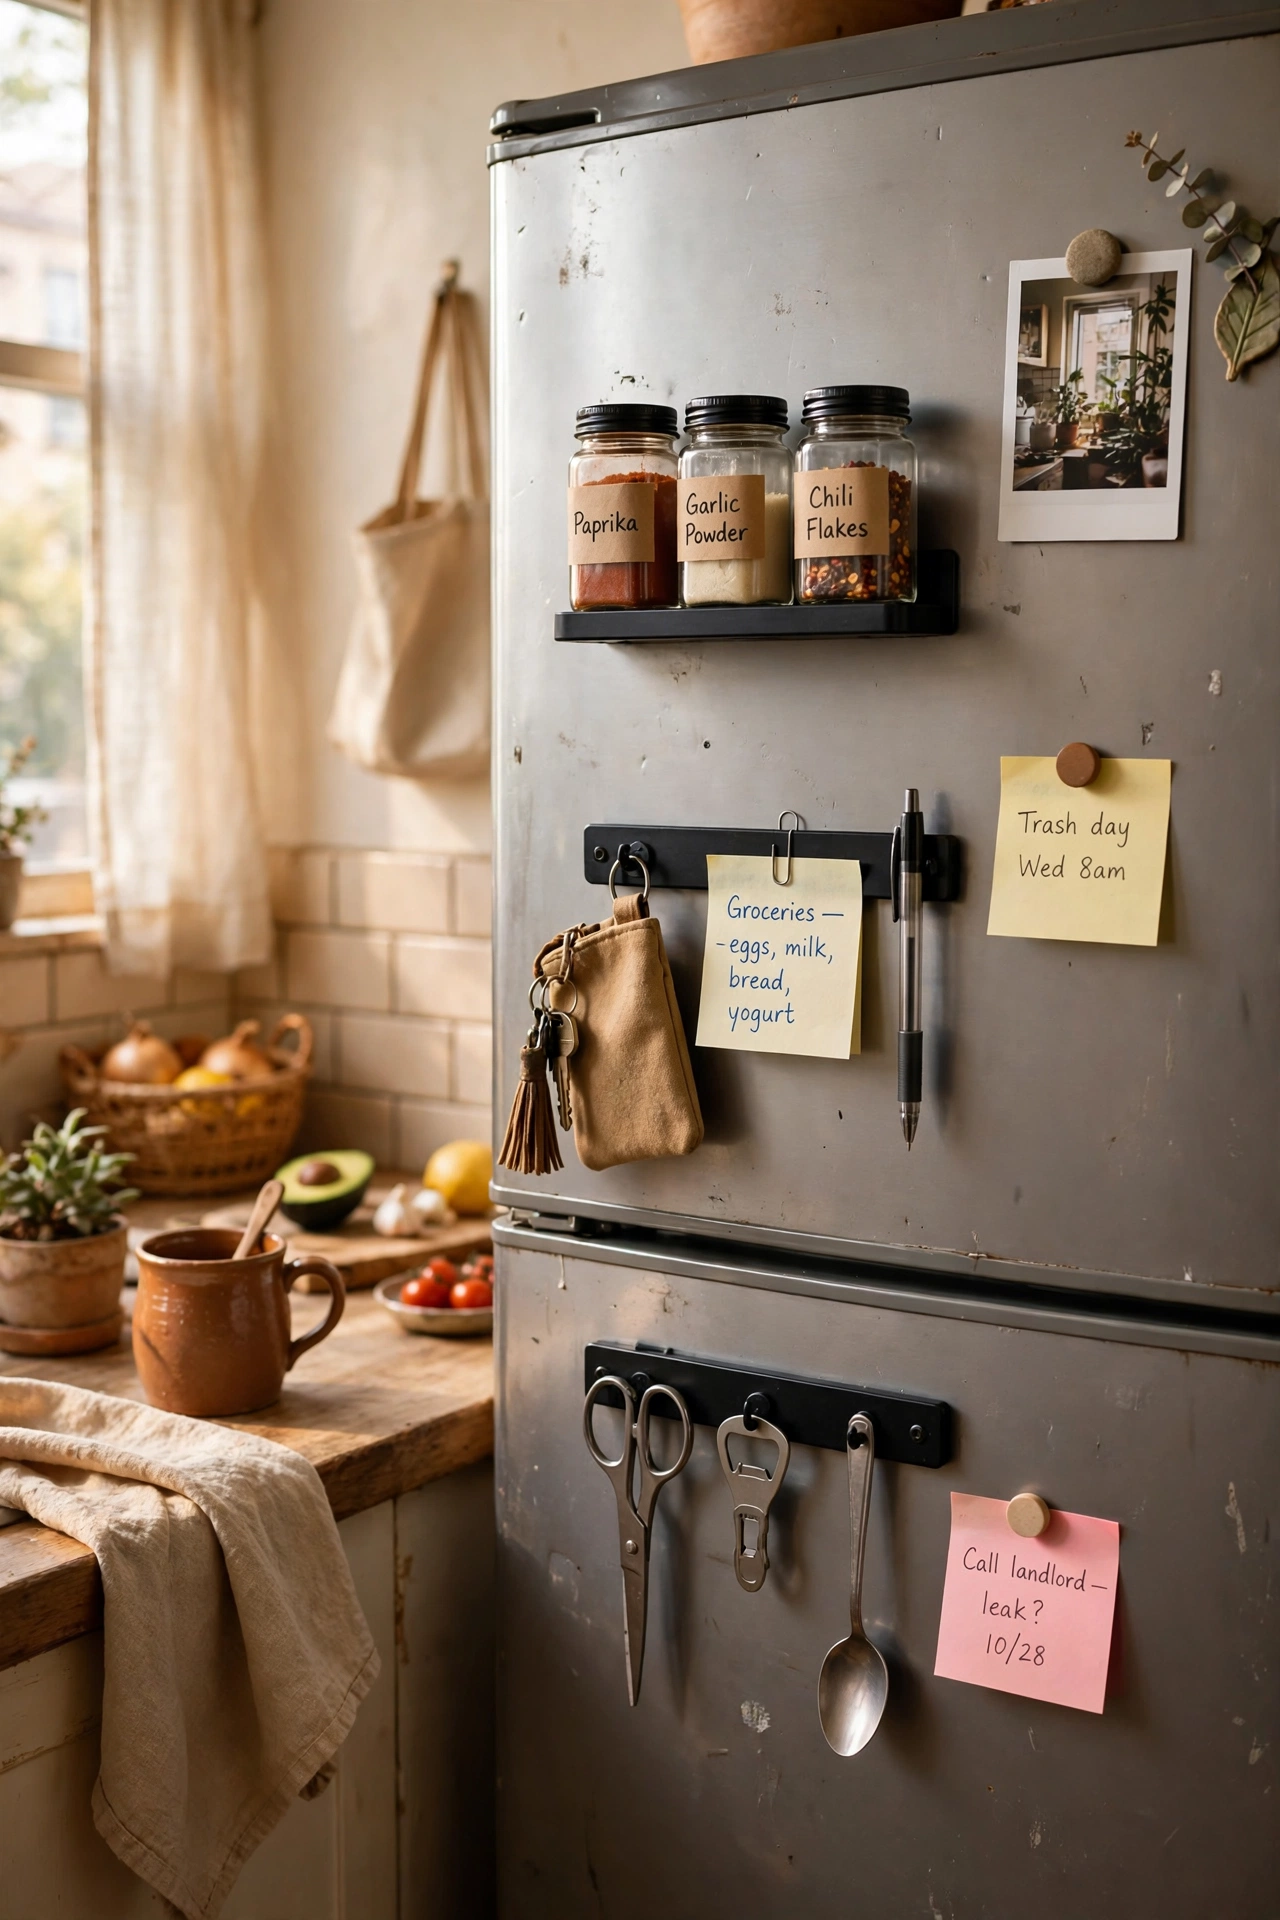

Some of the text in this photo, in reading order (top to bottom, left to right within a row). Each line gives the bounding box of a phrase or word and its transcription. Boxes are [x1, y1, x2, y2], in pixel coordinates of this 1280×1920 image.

[686, 491, 741, 515] Garlic
[809, 484, 853, 508] Chili
[573, 511, 639, 542] Paprika
[685, 521, 749, 546] Powder
[806, 517, 869, 540] Flakes
[1018, 810, 1130, 848] Trash day
[1019, 854, 1126, 881] Wed 8am
[727, 894, 815, 922] Groceries
[785, 935, 833, 964] milk,
[729, 965, 790, 997] bread,
[728, 1002, 795, 1033] yogurt
[963, 1546, 999, 1574] Call
[982, 1590, 1044, 1625] leak?
[986, 1632, 1046, 1666] 10/28
